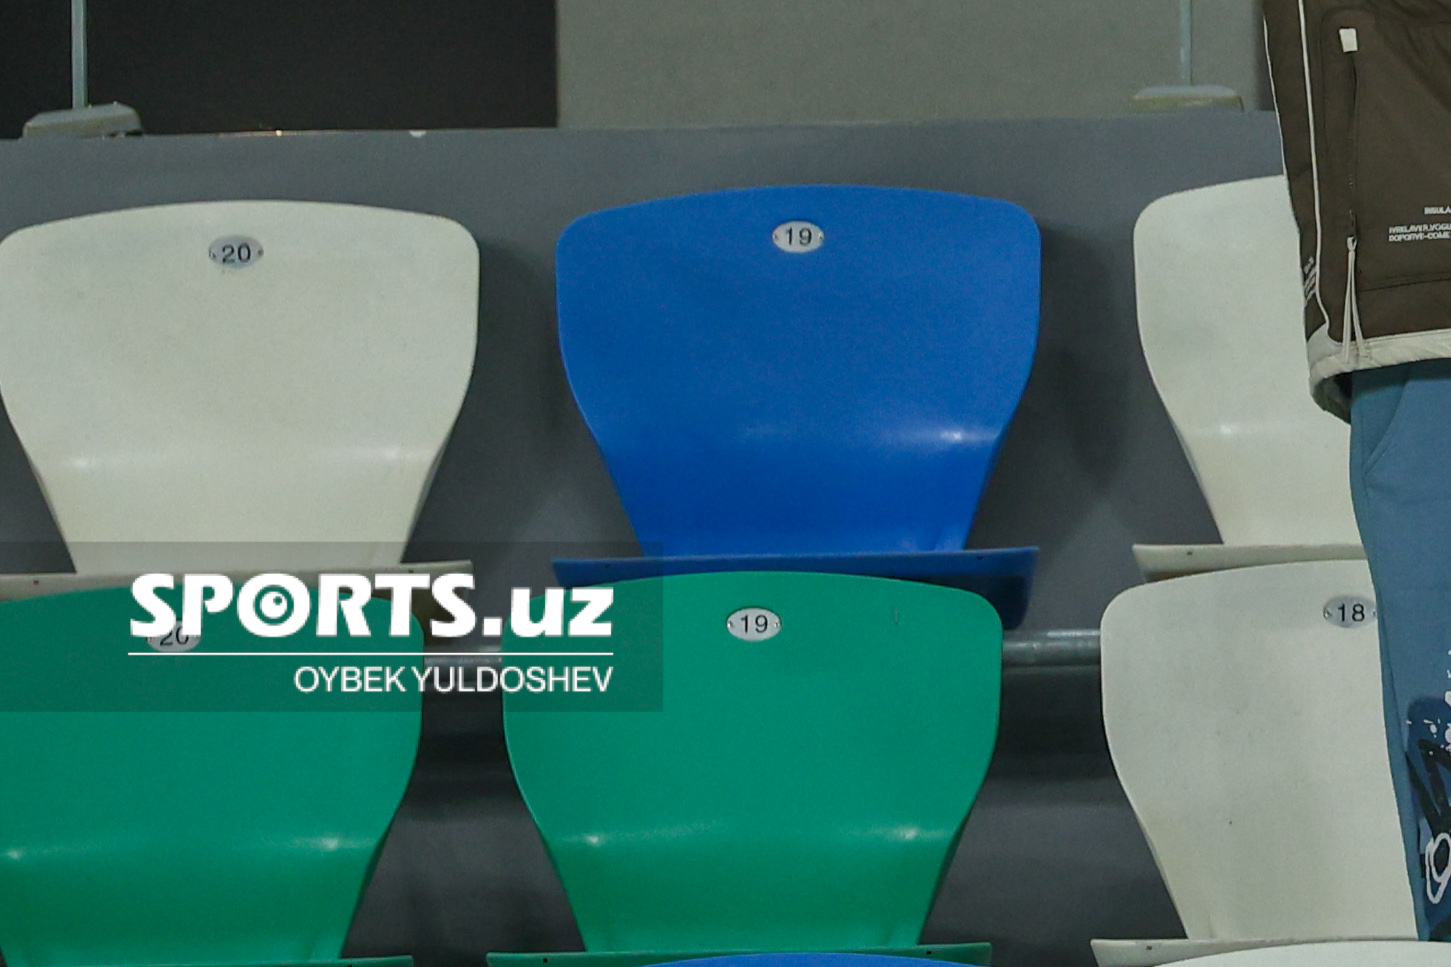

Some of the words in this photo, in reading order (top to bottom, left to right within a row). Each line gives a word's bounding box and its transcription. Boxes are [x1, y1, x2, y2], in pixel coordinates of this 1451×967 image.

[785, 227, 812, 246] 19
[222, 243, 251, 263] 20
[1338, 603, 1365, 622] 18
[741, 614, 768, 634] 19
